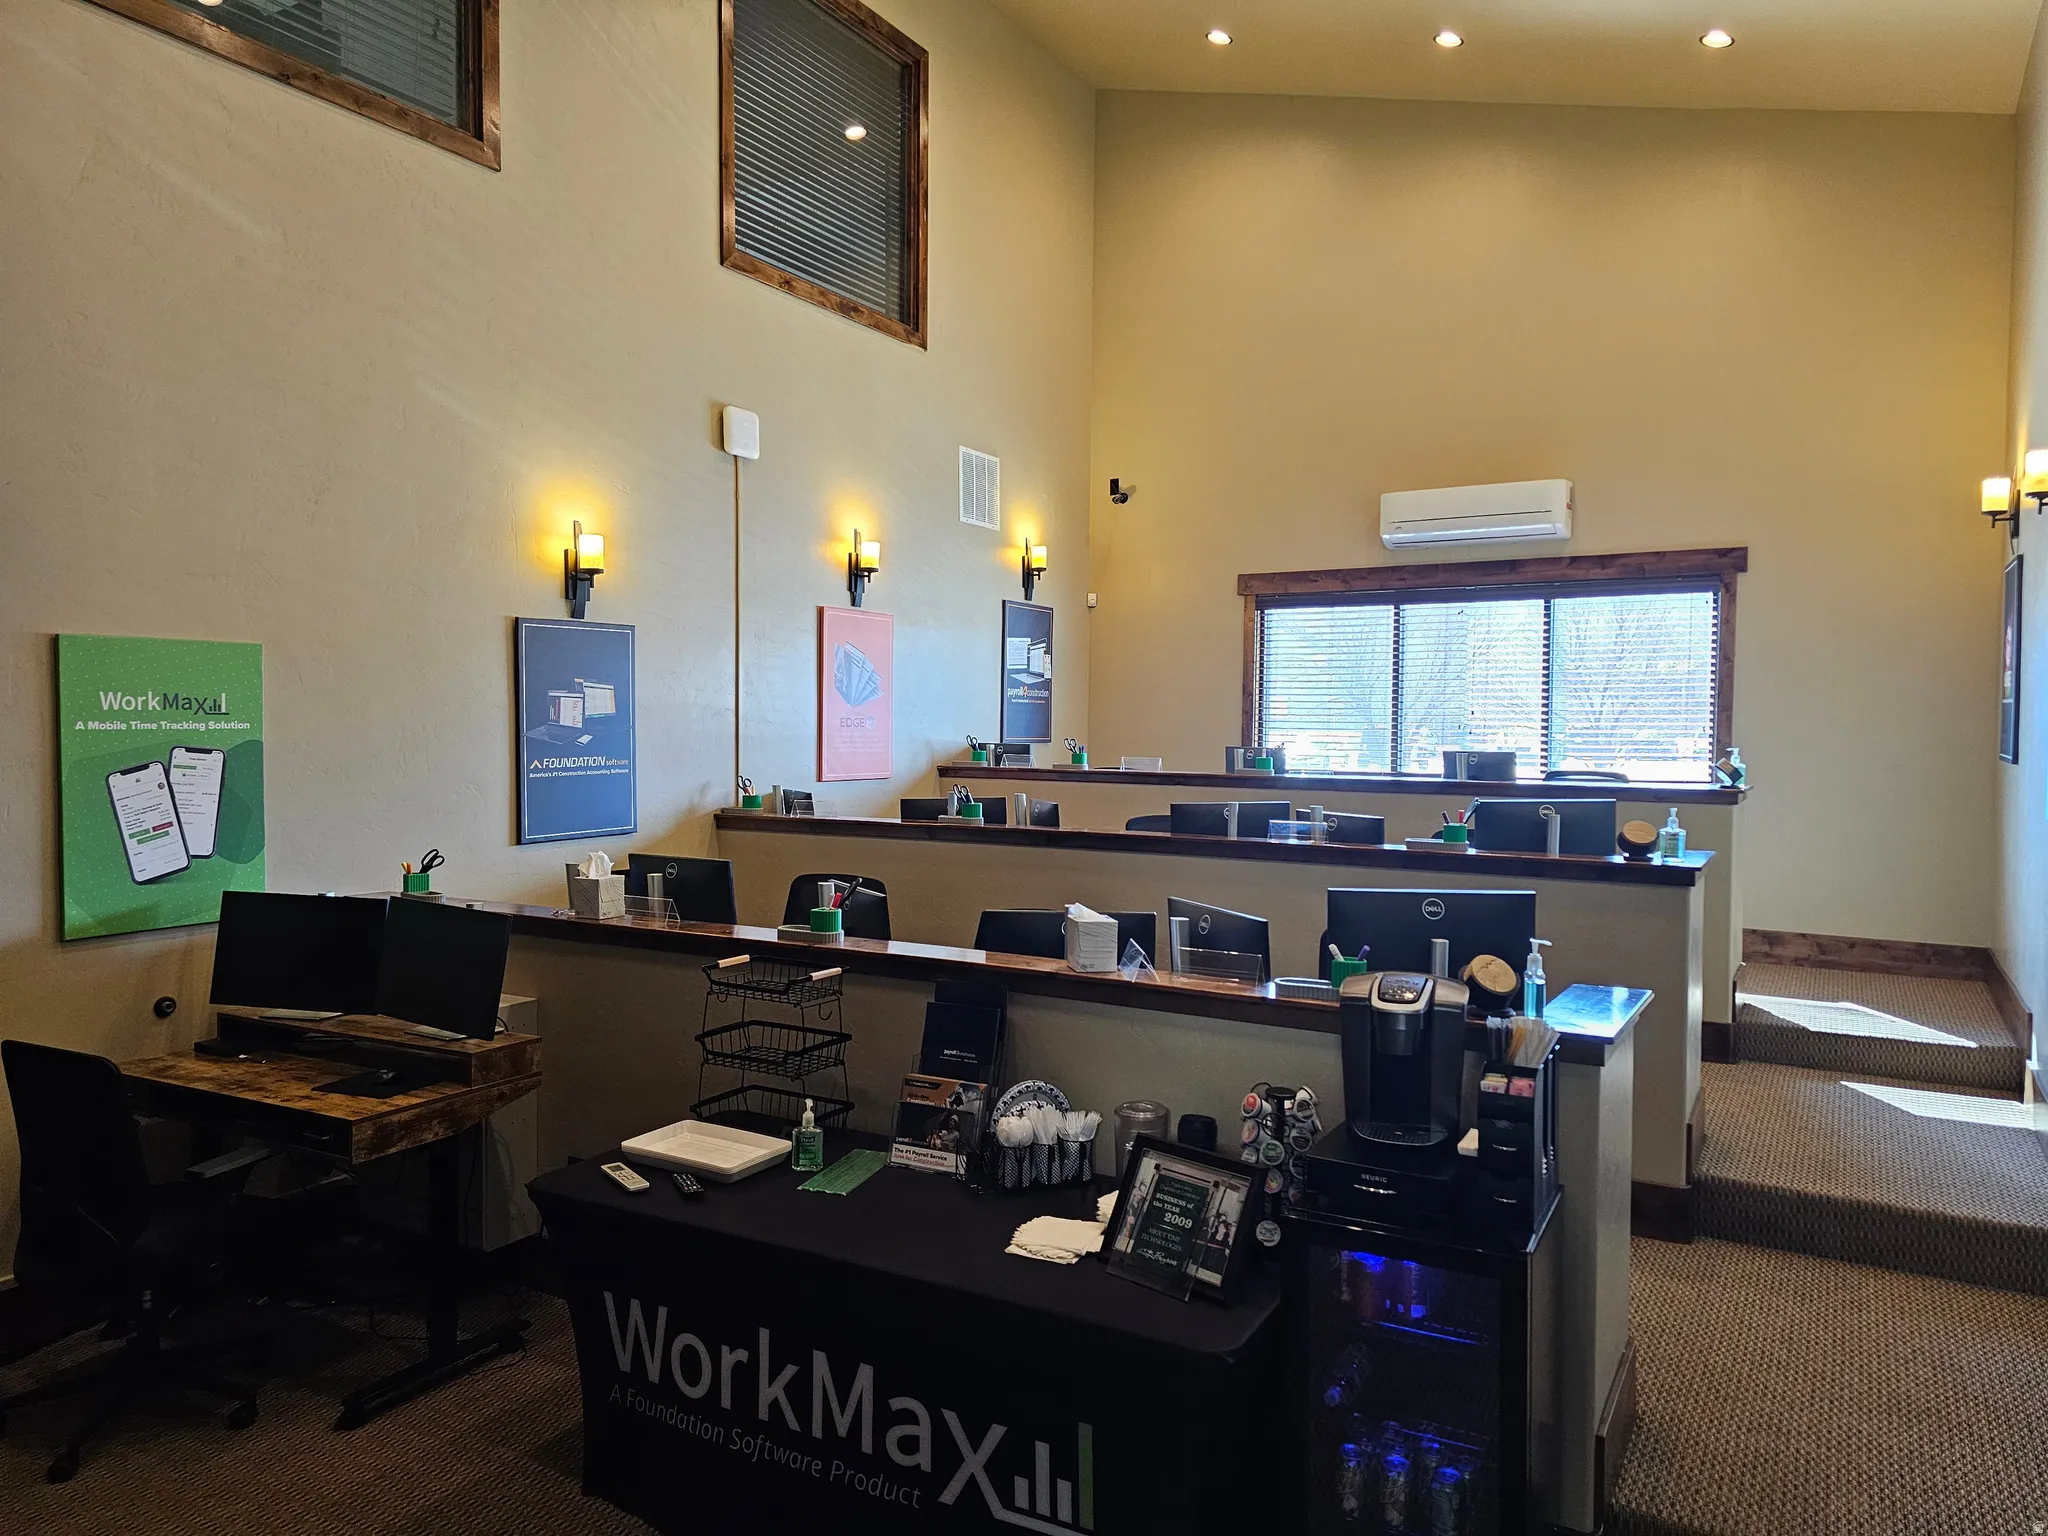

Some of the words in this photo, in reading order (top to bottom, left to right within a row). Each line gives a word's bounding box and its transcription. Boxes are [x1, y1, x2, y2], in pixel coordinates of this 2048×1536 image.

[1007, 685, 1050, 698] payroll4construction
[99, 691, 208, 716] WorkMax
[75, 721, 85, 730] A
[87, 721, 127, 730] Mobile
[130, 721, 158, 730] Time
[160, 720, 206, 731] Tracking
[208, 720, 251, 730] Solution
[840, 717, 865, 728] EDGE
[543, 756, 606, 769] FOUNDATION
[606, 758, 629, 766] software
[911, 1150, 929, 1158] Payroll
[930, 1153, 948, 1161] Service
[1361, 1172, 1389, 1183] KEURIG
[1155, 1192, 1187, 1207] BUSINESS
[1152, 1200, 1163, 1208] the
[1163, 1203, 1180, 1213] YEAR
[1163, 1212, 1193, 1229] 2009
[603, 1290, 1009, 1514] WorkMax
[608, 1384, 622, 1404] A
[626, 1387, 725, 1445] Foundation
[729, 1427, 823, 1478] Software
[829, 1459, 922, 1509] Product
